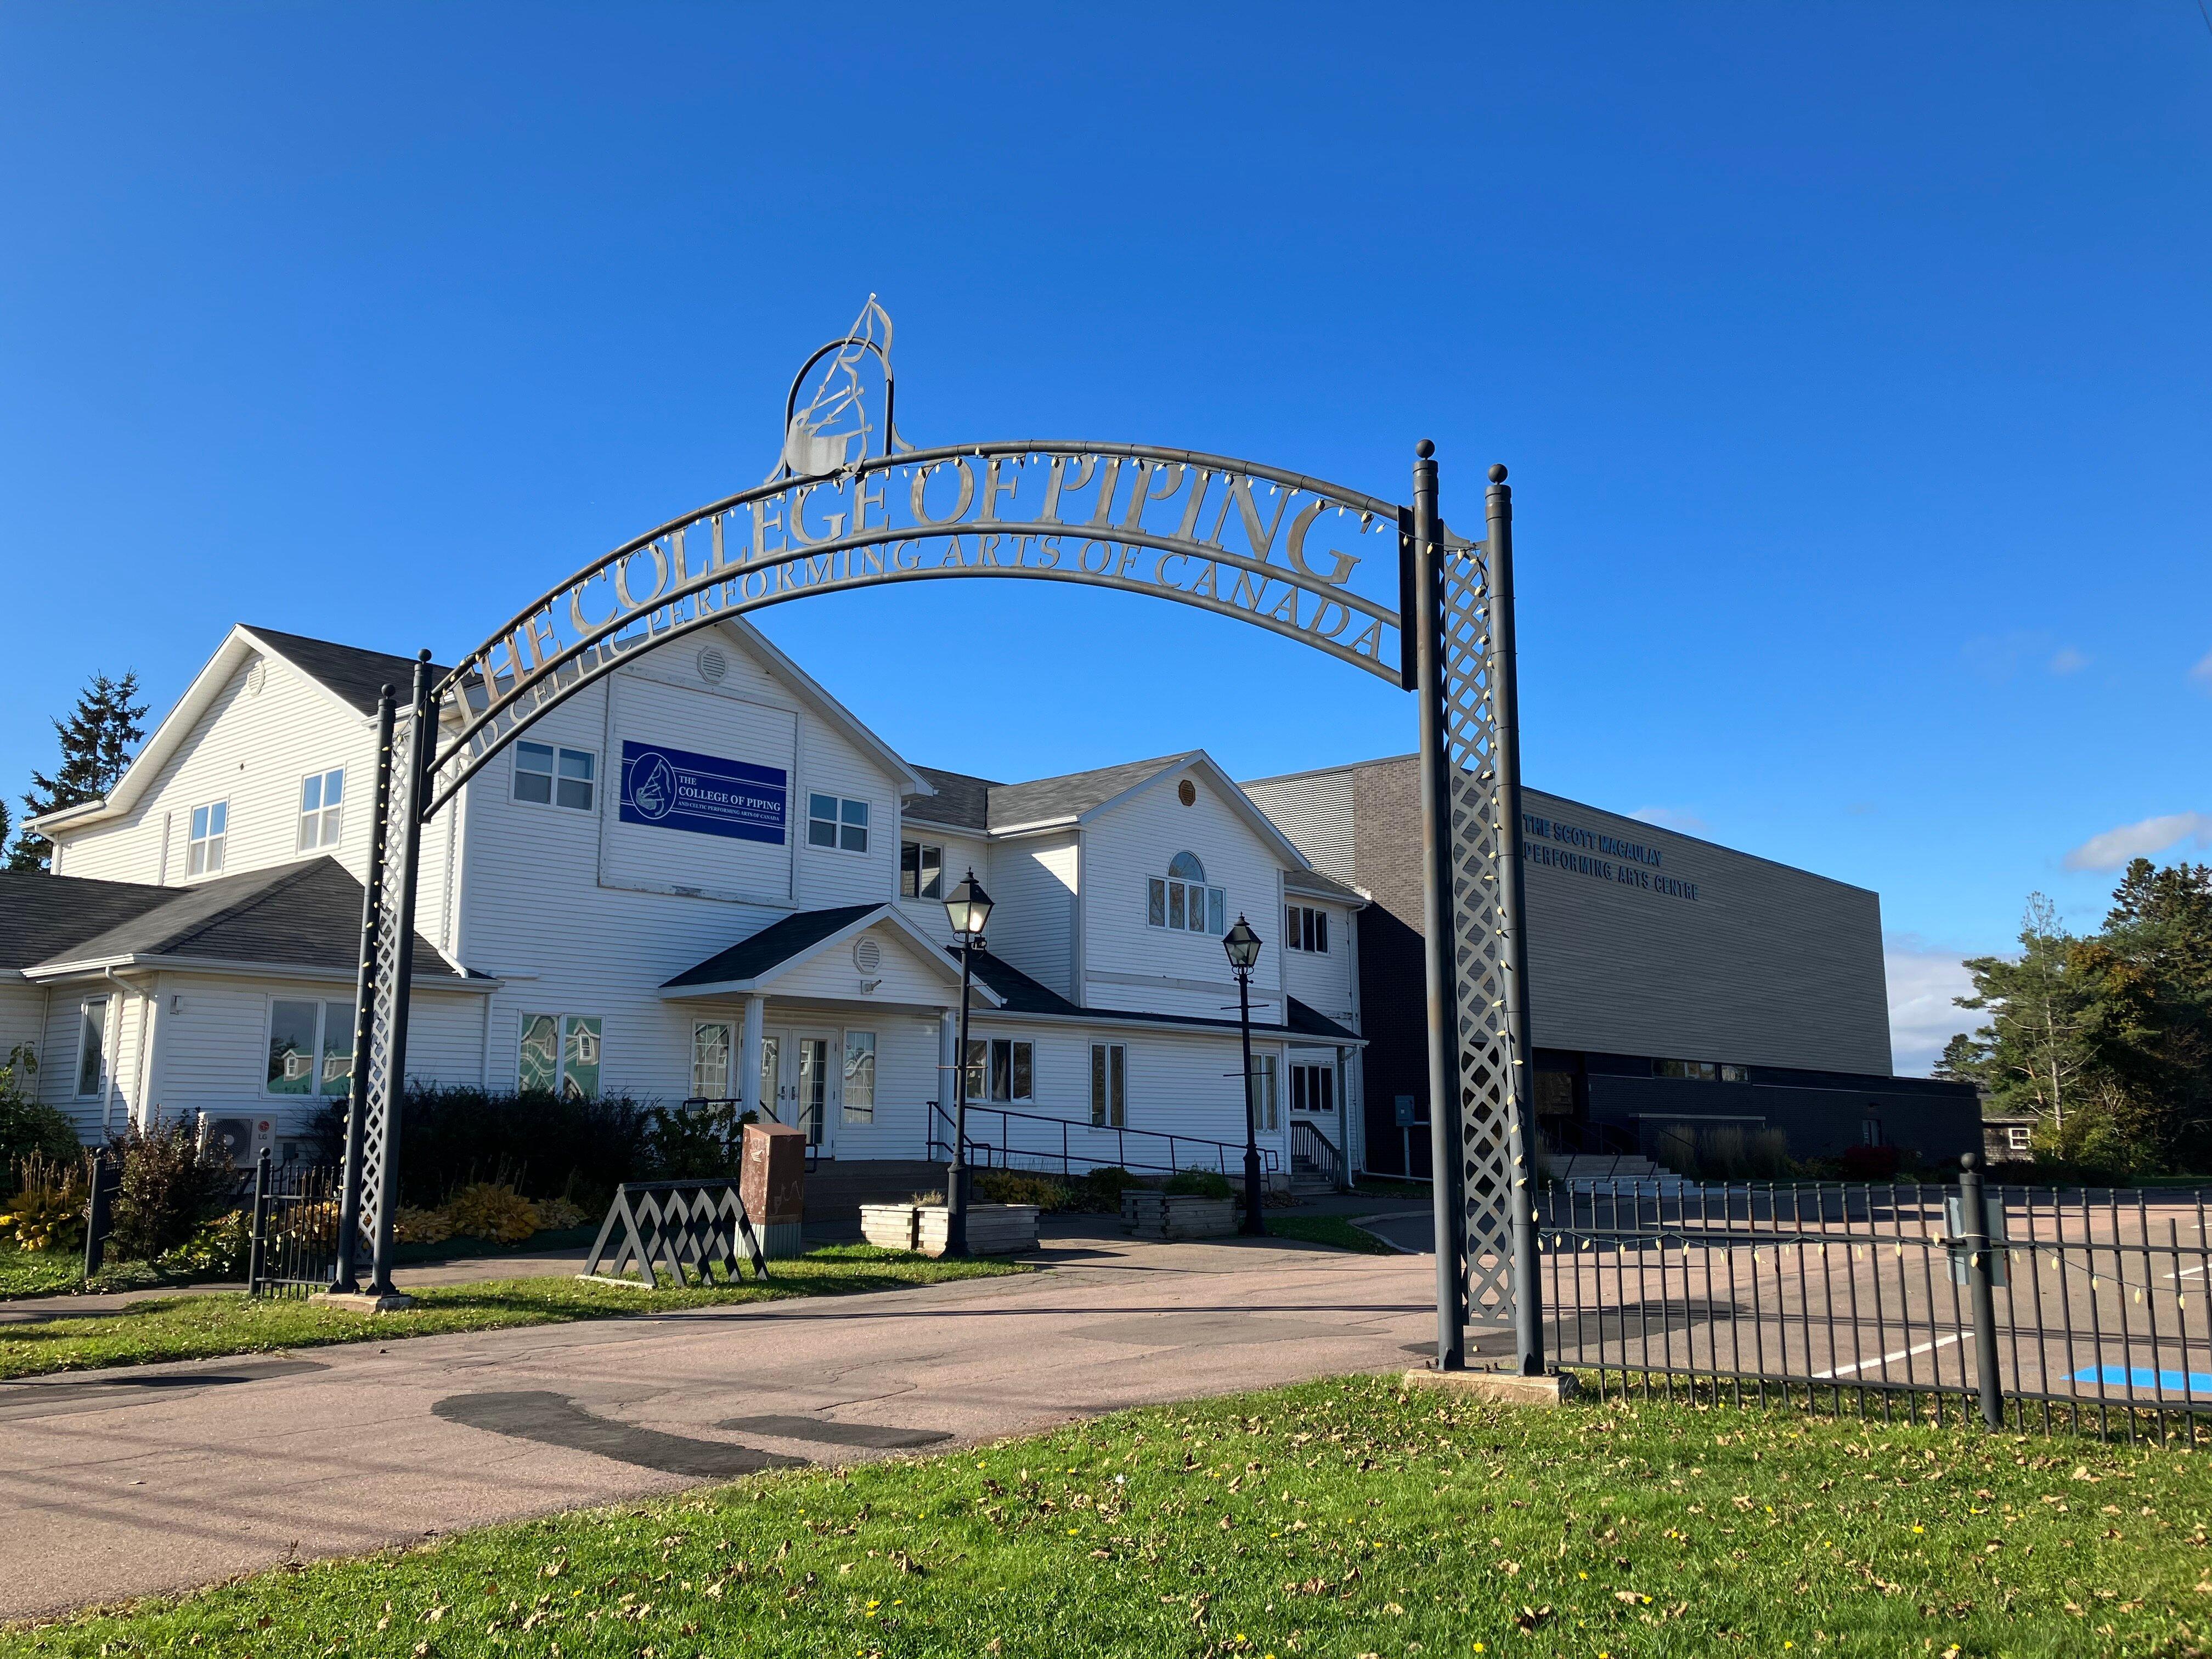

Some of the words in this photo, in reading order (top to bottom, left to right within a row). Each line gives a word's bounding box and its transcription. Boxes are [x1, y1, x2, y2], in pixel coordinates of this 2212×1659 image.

[439, 606, 565, 734] THE
[570, 471, 890, 636] COLLEGE
[911, 453, 1025, 525] OF
[1035, 453, 1374, 584] PIPING
[646, 539, 921, 641] PERFORMING
[941, 534, 1061, 569] ARTS
[1077, 538, 1141, 578] OF
[1155, 552, 1382, 662] CANADA
[679, 776, 696, 785] THE
[679, 787, 728, 803] COLLEGE
[730, 795, 745, 805] OF
[747, 798, 780, 811] PIPING
[708, 804, 740, 815] PERFORMING
[1522, 814, 1550, 838] THE
[1554, 822, 1596, 850] SCOTT
[1599, 834, 1663, 867] MACAULAY
[1523, 842, 1613, 881] PERFORMING
[1618, 866, 1651, 889] ARTS
[1655, 875, 1699, 901] CENTRE
